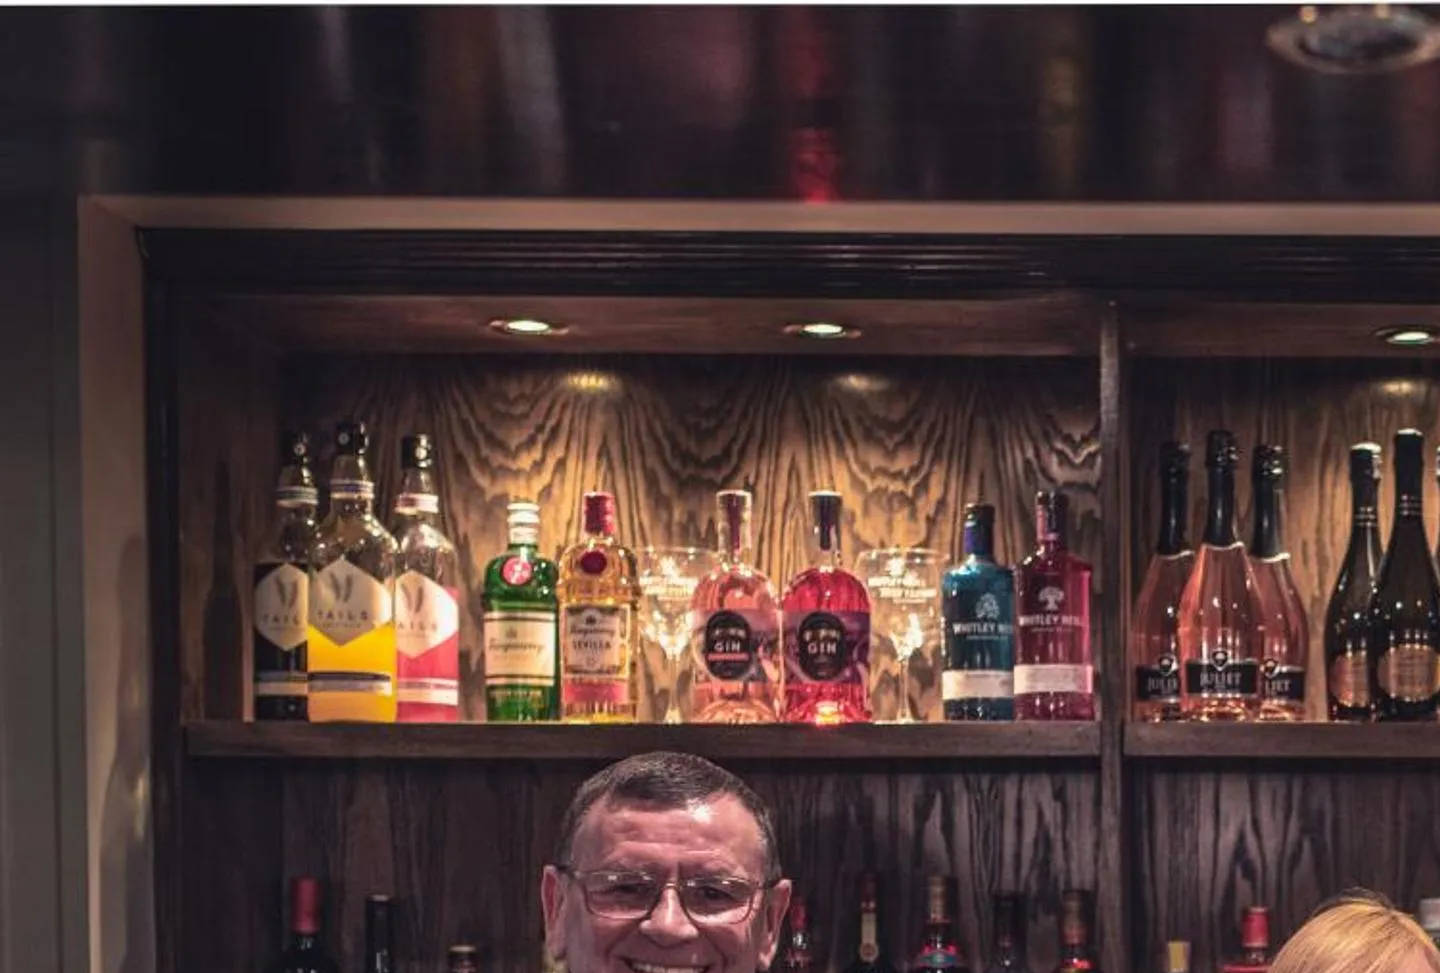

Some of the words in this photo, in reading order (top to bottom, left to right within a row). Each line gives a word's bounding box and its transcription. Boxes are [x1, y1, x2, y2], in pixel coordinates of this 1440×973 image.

[316, 609, 369, 622] TAILS
[714, 640, 741, 653] GIN
[808, 642, 837, 655] GIN
